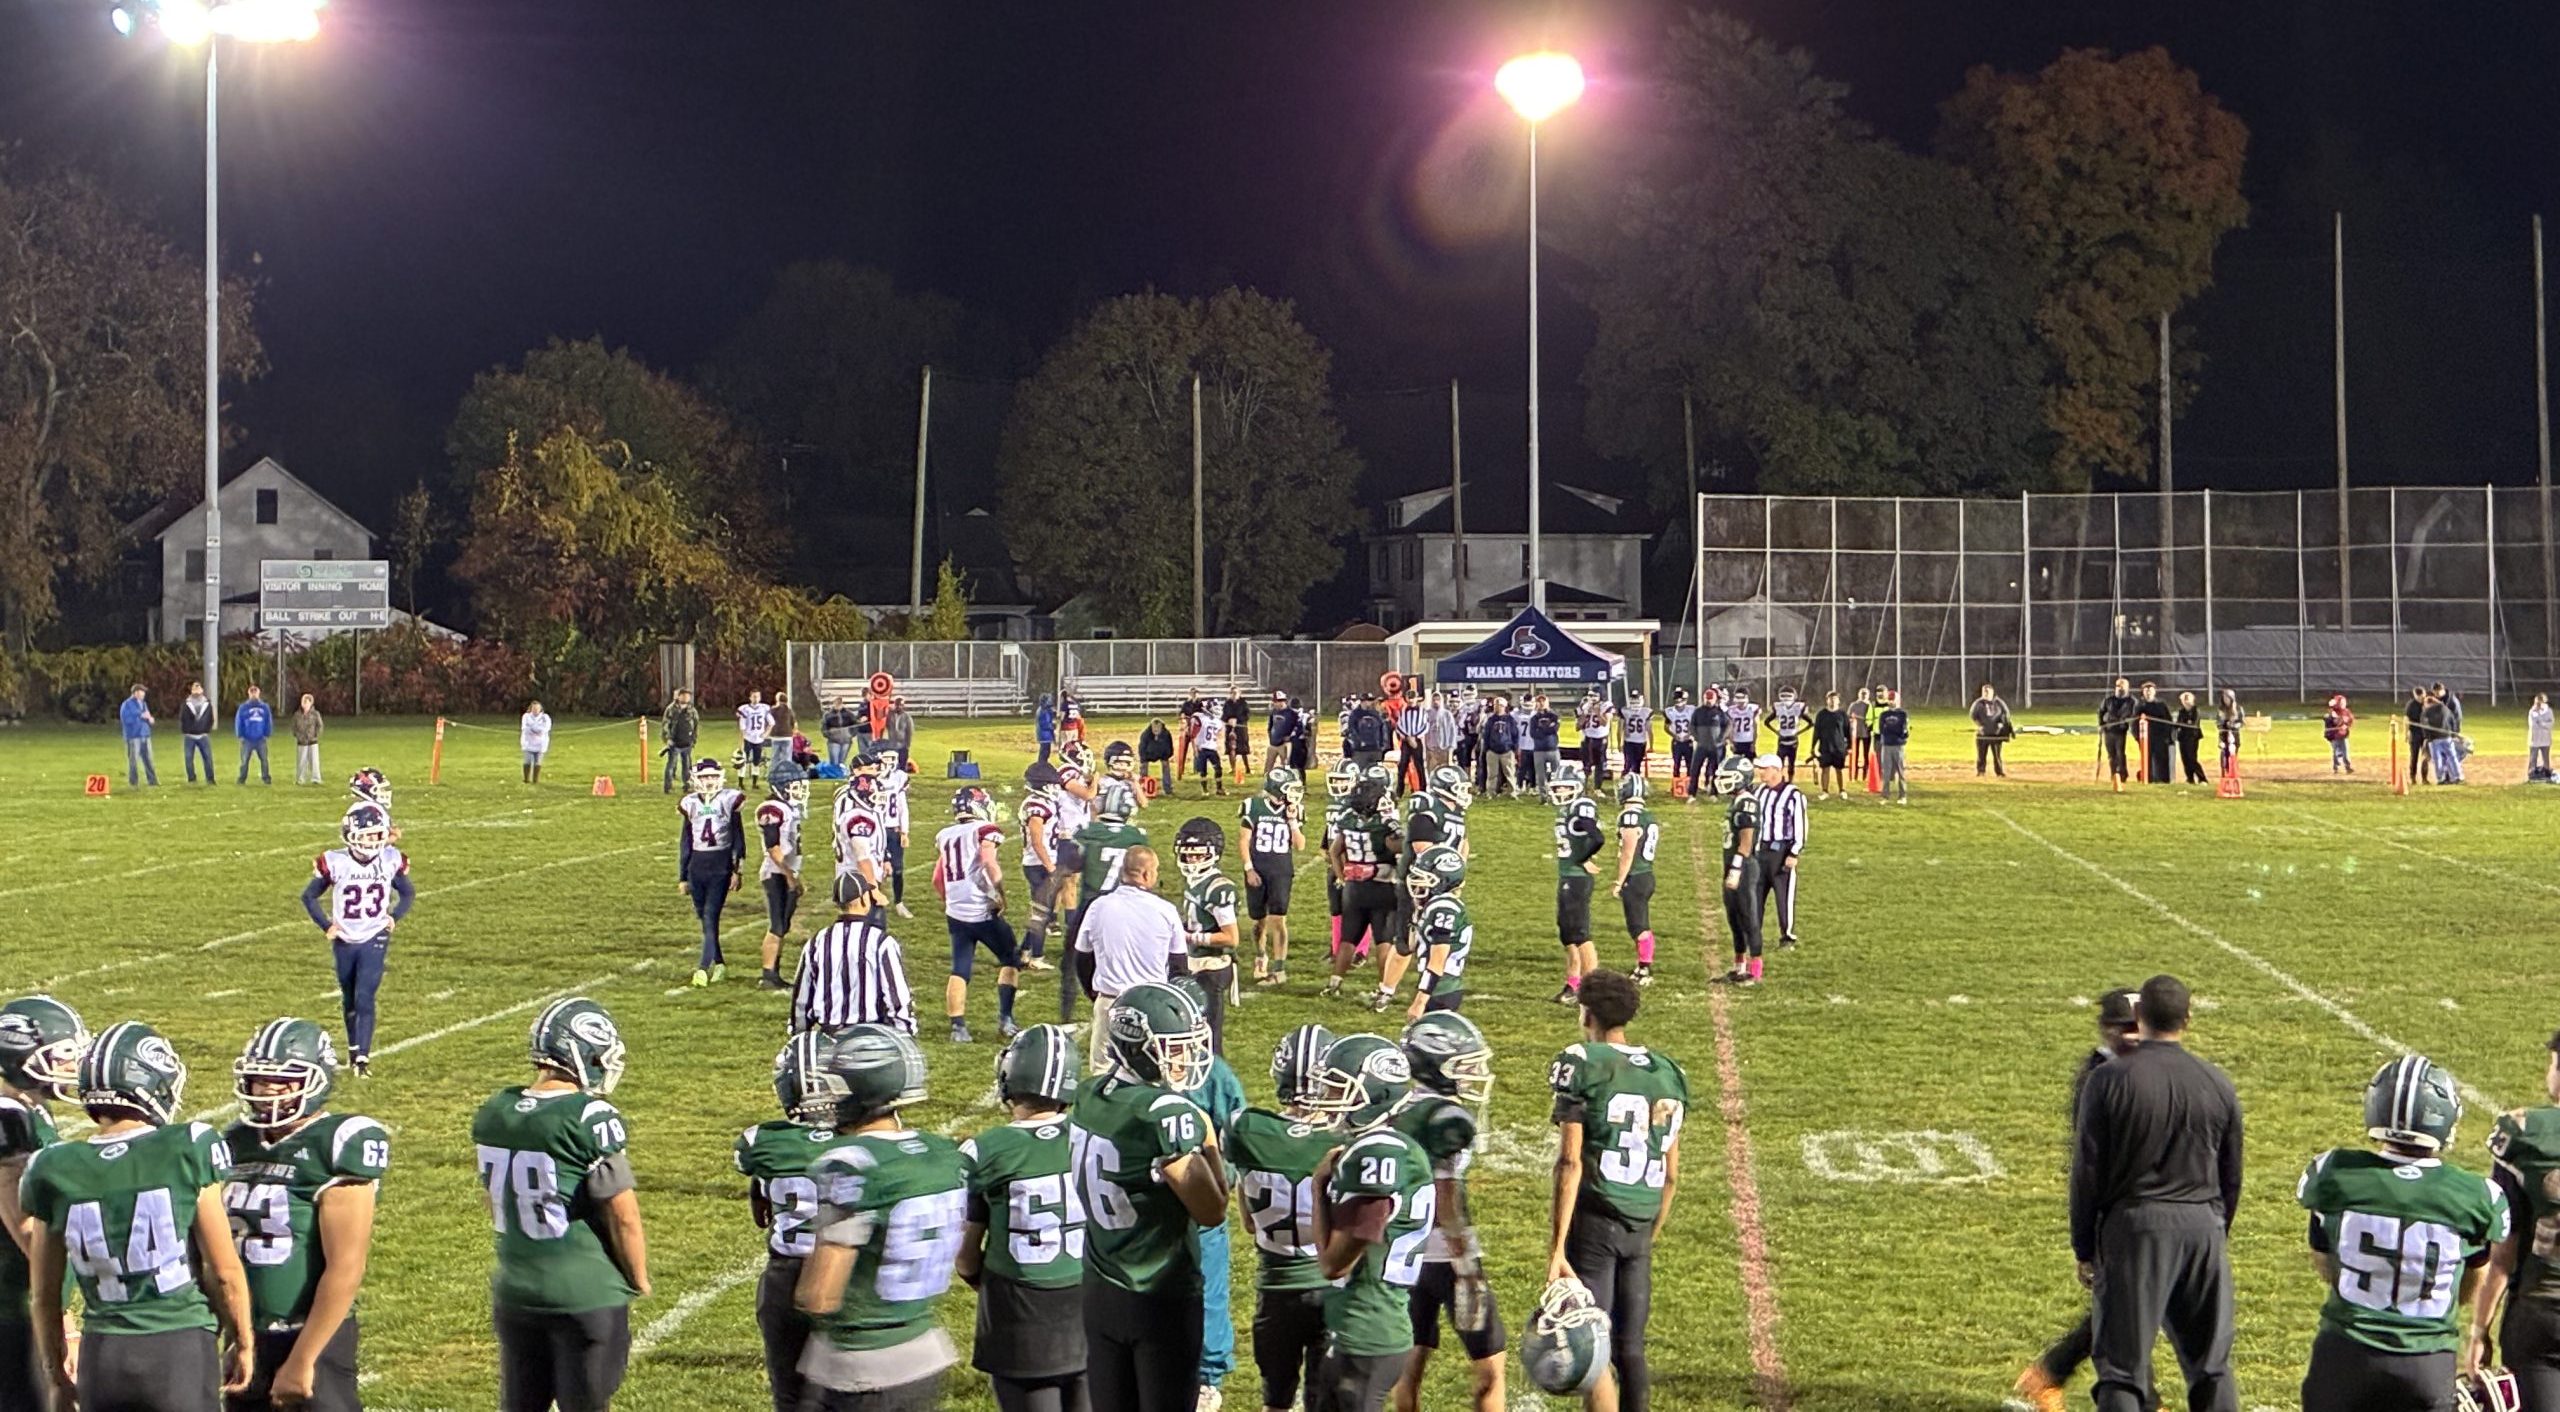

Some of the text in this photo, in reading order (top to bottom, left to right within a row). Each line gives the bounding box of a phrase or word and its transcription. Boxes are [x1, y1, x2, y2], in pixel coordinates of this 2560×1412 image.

[264, 582, 385, 592] VISITOR INNING HOME
[265, 611, 291, 622] BALL
[298, 611, 331, 621] STRIKE
[338, 611, 358, 621] OUT
[1466, 666, 1581, 679] MAHAR SENATORS
[1733, 717, 1751, 733] 72
[1779, 715, 1796, 730] 22
[87, 776, 106, 793] 20
[700, 817, 718, 848] 4
[943, 836, 966, 883] 11
[342, 883, 385, 919] 23
[1434, 912, 1456, 930] 22
[1549, 1061, 1575, 1087] 33
[592, 1118, 626, 1148] 78
[1161, 1112, 1195, 1143] 76
[1600, 1092, 1685, 1188] 33
[362, 1139, 390, 1168] 63
[1069, 1122, 1139, 1231] 76
[1360, 1156, 1397, 1186] 20
[476, 1143, 570, 1240] 78
[221, 1180, 294, 1265] 63
[65, 1187, 192, 1302] 44
[2338, 1210, 2462, 1319] 50
